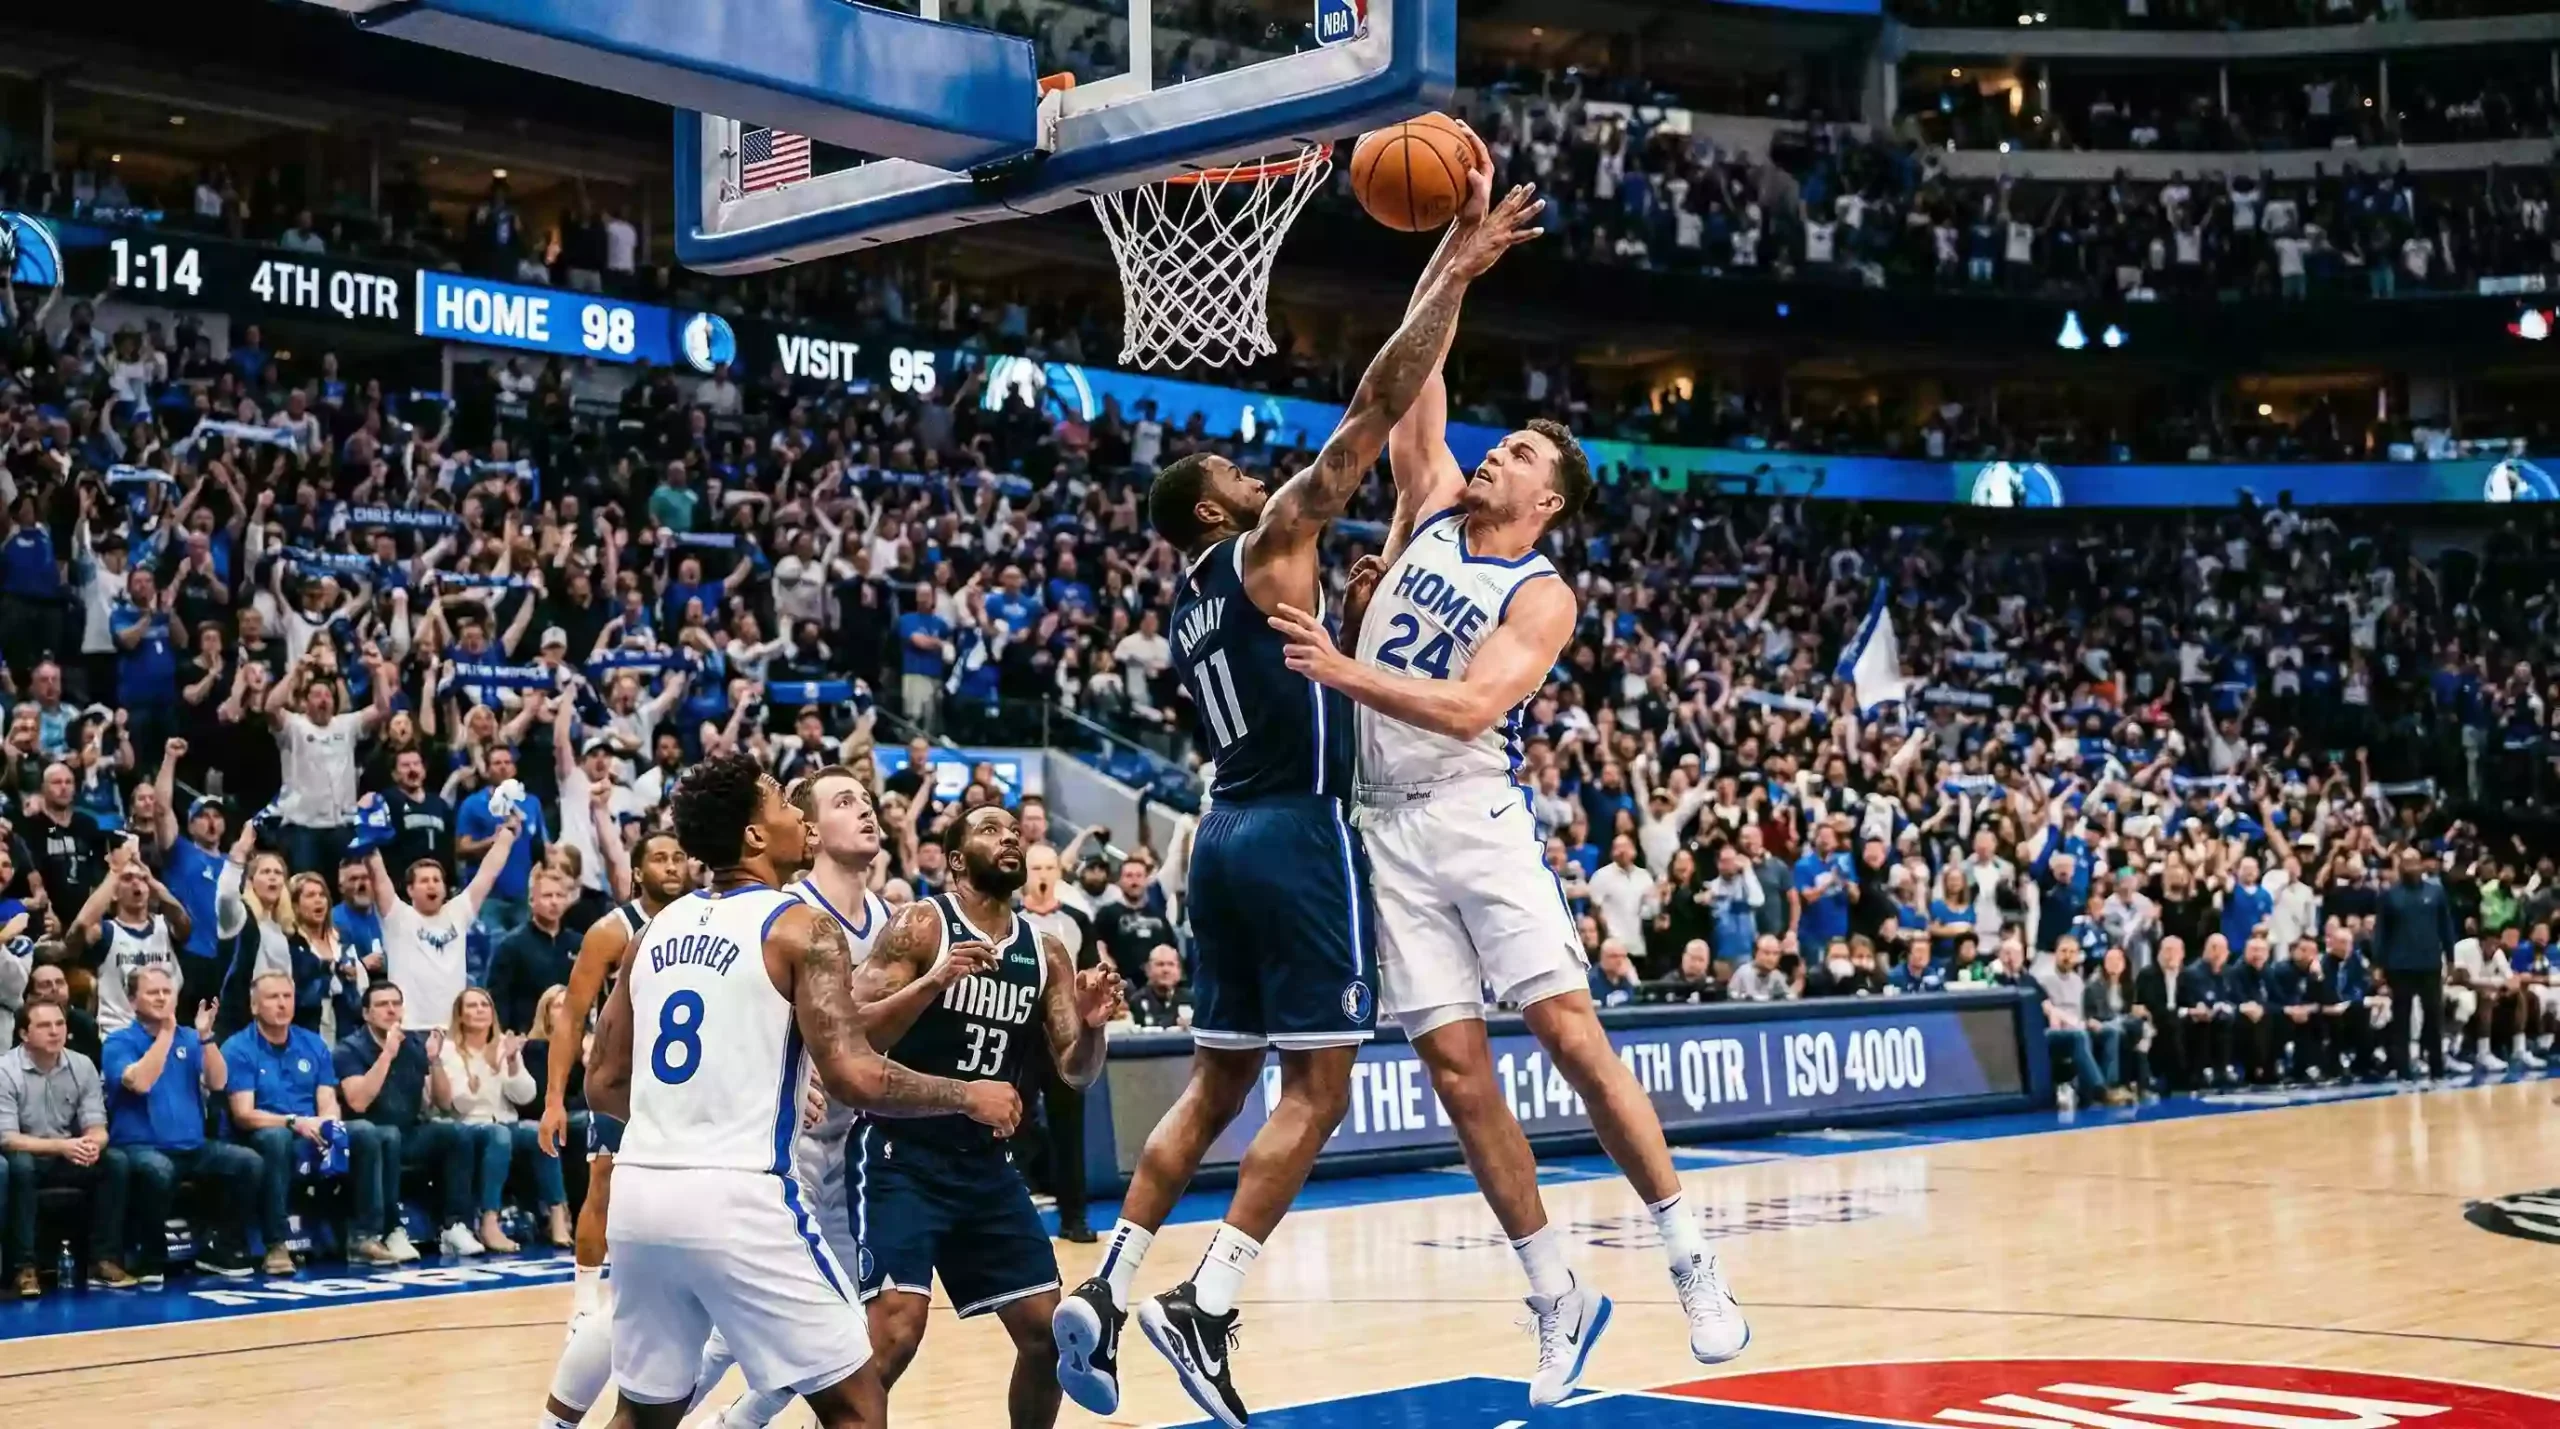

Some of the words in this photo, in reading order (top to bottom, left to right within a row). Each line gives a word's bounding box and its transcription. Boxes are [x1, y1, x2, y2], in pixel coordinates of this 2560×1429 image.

[1323, 9, 1349, 37] NBA
[111, 238, 202, 296] 1:14
[250, 261, 320, 308] 4TH
[330, 271, 399, 319] QTR
[437, 285, 549, 342] HOME
[582, 304, 635, 354] 98
[777, 333, 859, 382] VISIT
[889, 347, 936, 395] 95
[1392, 563, 1489, 647] HOME
[1375, 612, 1455, 680] 24
[1193, 647, 1249, 749] 11
[651, 989, 704, 1084] 8
[956, 1022, 1008, 1077] 33
[1350, 1059, 1426, 1134] THE
[1497, 1051, 1586, 1120] 1:14
[1679, 1038, 1748, 1112] QTR
[1783, 1031, 1839, 1097] ISO
[1844, 1026, 1926, 1092] 4000
